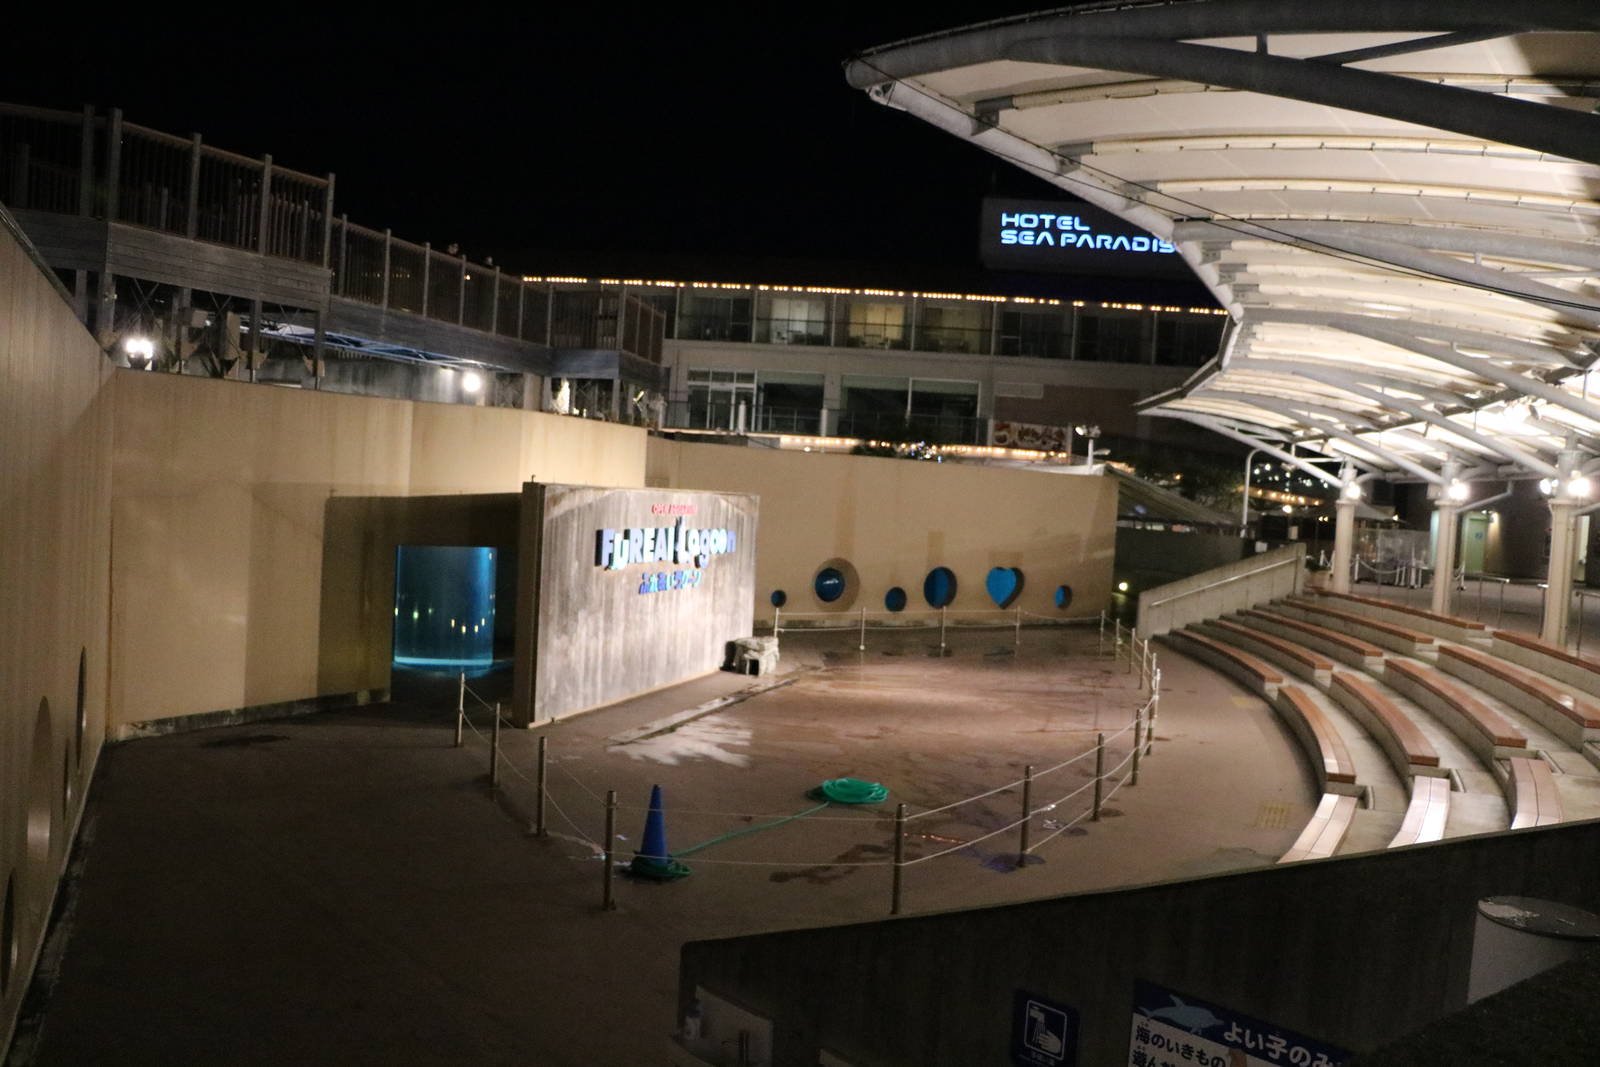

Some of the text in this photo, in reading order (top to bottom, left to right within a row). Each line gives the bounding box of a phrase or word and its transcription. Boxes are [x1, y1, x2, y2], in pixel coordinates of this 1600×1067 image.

[1000, 212, 1091, 231] HOTEL
[1000, 229, 1055, 247] SEA
[1135, 1024, 1226, 1067] 海のいきもの
[1223, 1021, 1343, 1067] よい子のみ
